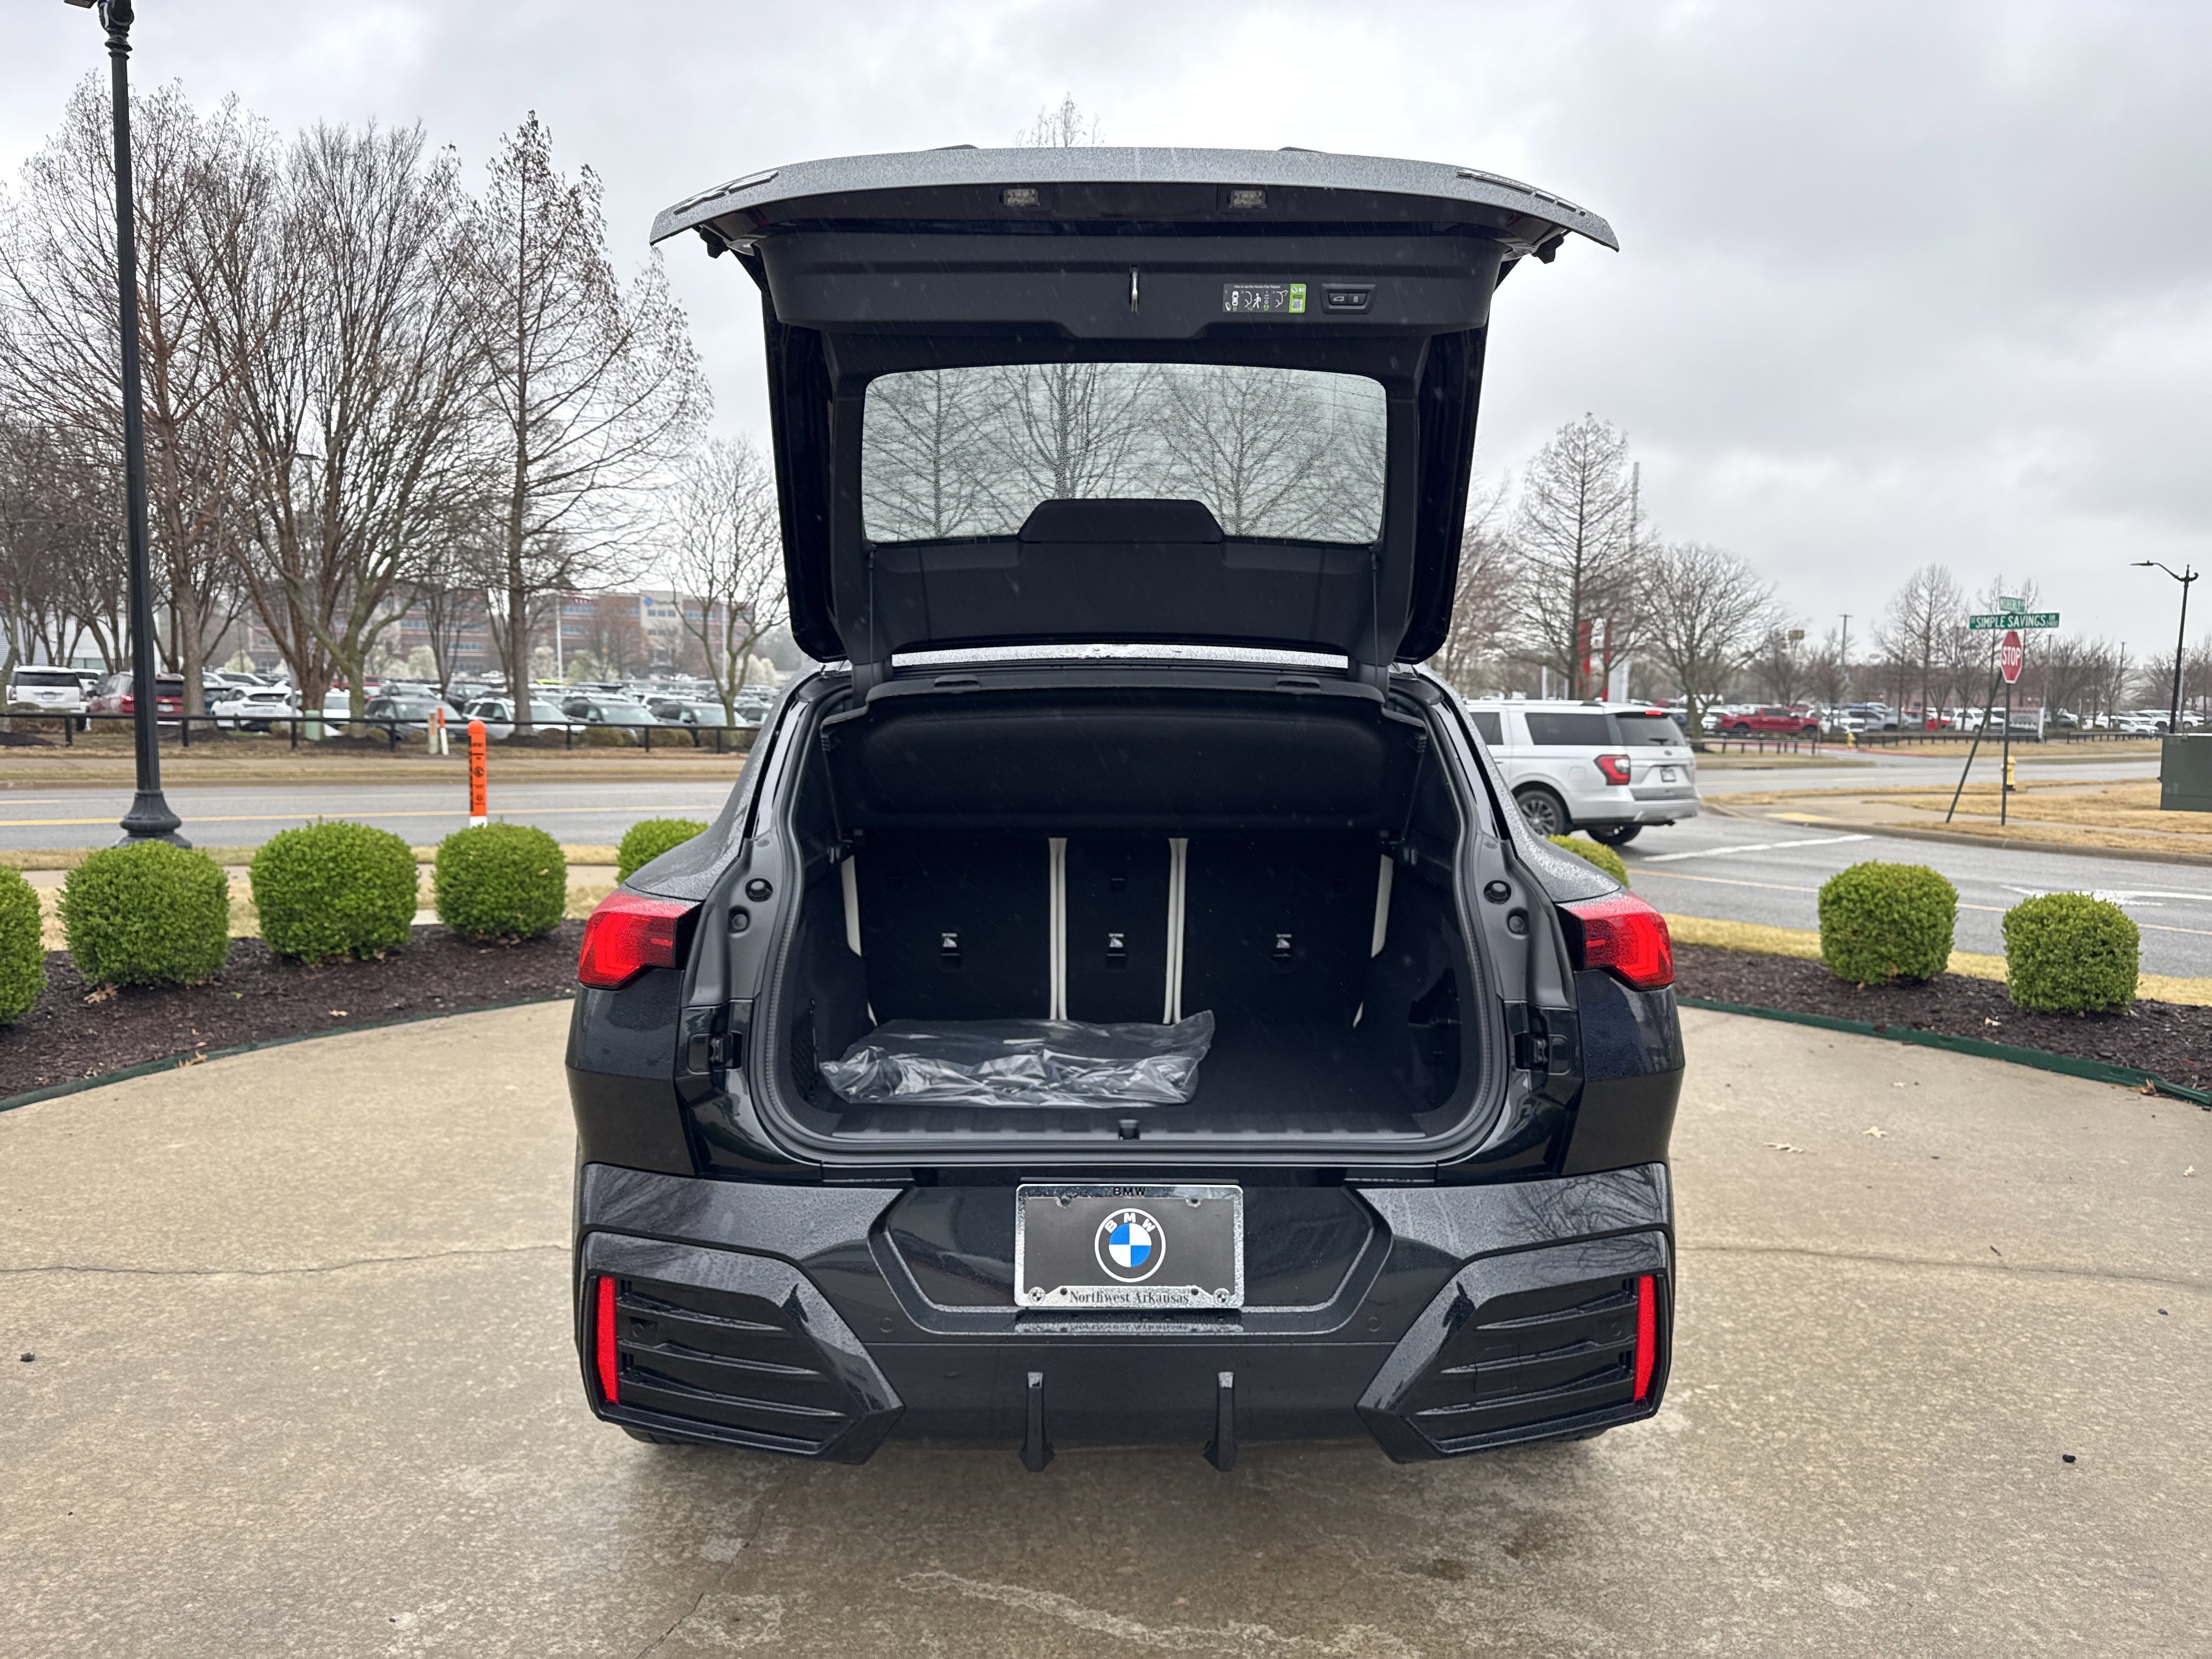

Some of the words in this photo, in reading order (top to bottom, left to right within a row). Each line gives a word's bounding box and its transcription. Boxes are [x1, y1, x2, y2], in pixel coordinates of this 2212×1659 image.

[1976, 616, 2005, 628] SIMPLE
[2007, 614, 2046, 627] SAVINGS
[2002, 646, 2021, 667] STOP
[1113, 1187, 1146, 1196] BMW
[1104, 1212, 1156, 1233] BMW
[1070, 1291, 1129, 1304] Northwest
[1135, 1291, 1189, 1304] Arkansas
